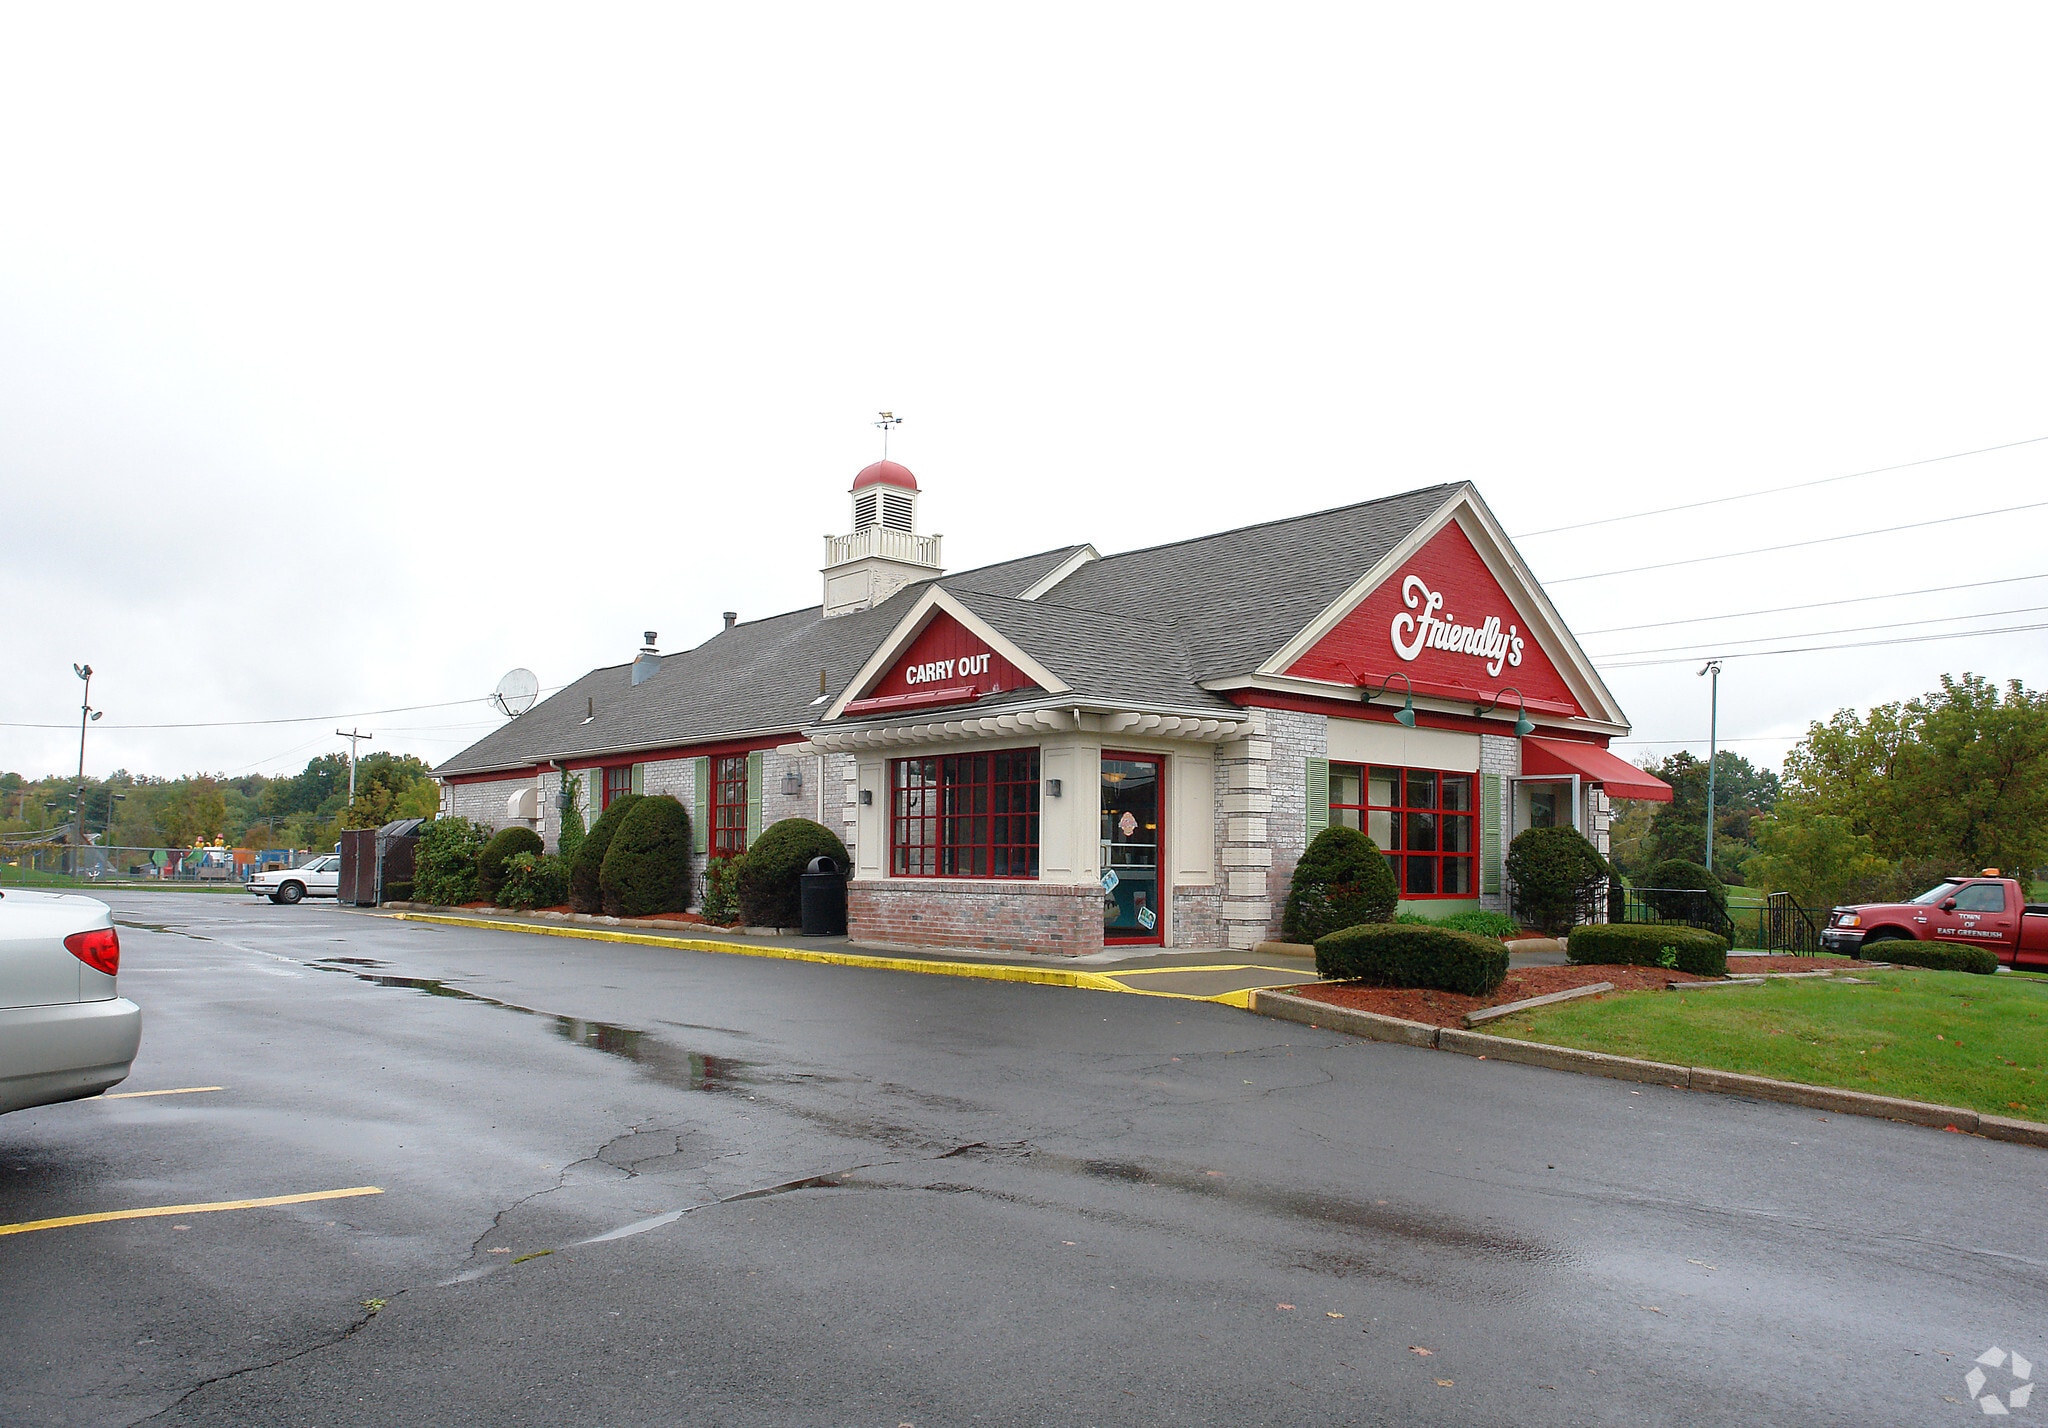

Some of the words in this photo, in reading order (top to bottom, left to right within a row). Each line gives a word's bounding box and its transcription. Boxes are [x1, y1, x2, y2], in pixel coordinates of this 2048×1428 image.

[1391, 575, 1525, 677] Friendly's
[906, 659, 956, 685] CARRY
[958, 653, 991, 677] OUT
[1957, 929, 2003, 938] GREENBUSH
